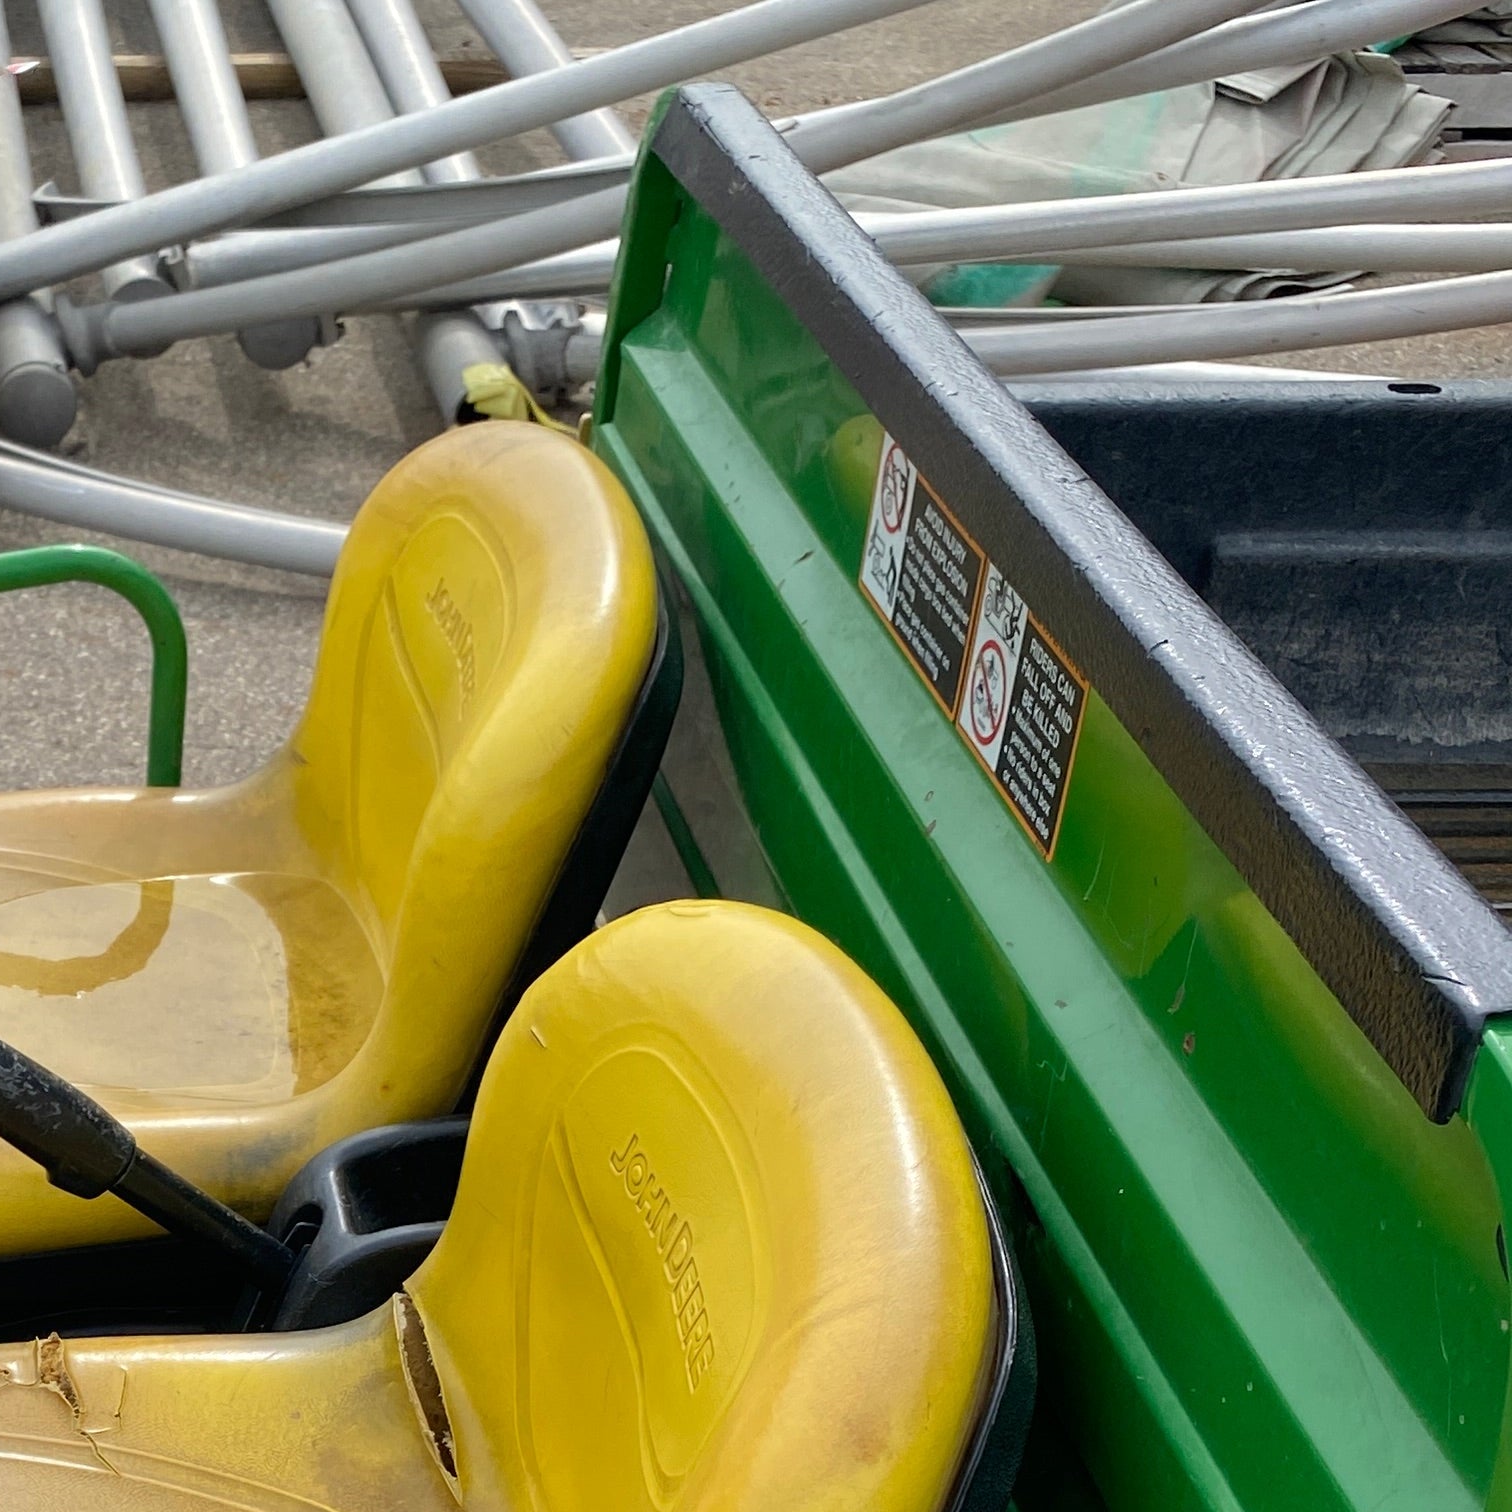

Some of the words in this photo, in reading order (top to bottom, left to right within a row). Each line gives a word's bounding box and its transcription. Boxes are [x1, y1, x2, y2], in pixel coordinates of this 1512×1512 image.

[915, 518, 934, 548] FROM
[931, 540, 968, 598] EXPLOSION
[1021, 657, 1038, 692] FALL
[1040, 681, 1058, 710] OFF
[1054, 703, 1072, 734] AND
[1030, 638, 1058, 684] RIDERS
[1057, 676, 1076, 706] CAN
[1022, 689, 1035, 714] BE
[1032, 702, 1060, 748] KILLED
[610, 1133, 678, 1255] JOHN
[663, 1221, 716, 1395] DEERE
